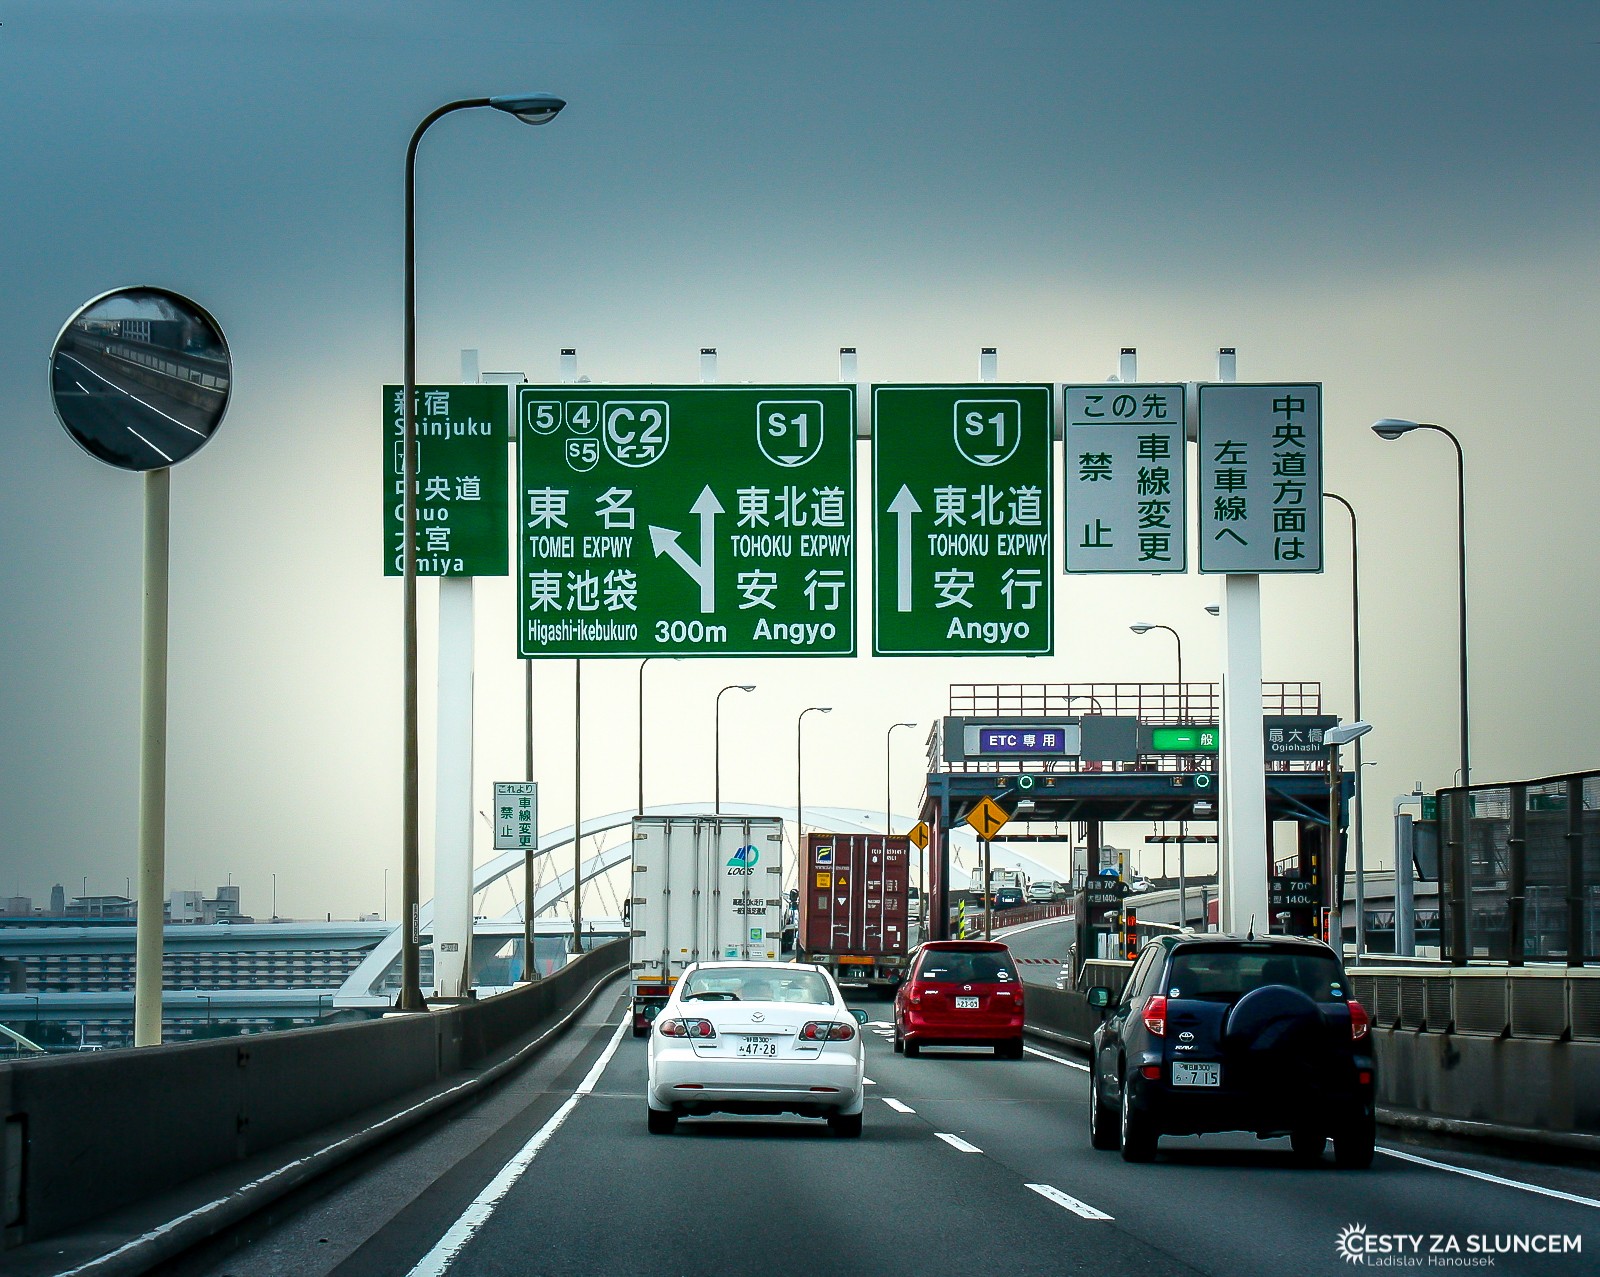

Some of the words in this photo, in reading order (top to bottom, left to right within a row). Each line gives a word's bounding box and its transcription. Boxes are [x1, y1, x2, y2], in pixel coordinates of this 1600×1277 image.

[536, 406, 554, 428] 5
[572, 406, 591, 428] 4
[1084, 393, 1168, 419] この先
[607, 408, 663, 444] C2
[768, 412, 808, 448] S1
[965, 412, 1005, 447] S1
[569, 444, 596, 463] S5
[1272, 394, 1307, 561] 中央道方面は
[736, 485, 845, 528] 東北道
[933, 484, 1042, 528] 東北道
[1078, 452, 1114, 549] 禁止
[1137, 433, 1172, 563] 車線変更
[1213, 439, 1248, 547] 左車線へ
[527, 486, 636, 530] 東名
[530, 536, 574, 559] TOMEI
[583, 536, 632, 559] EXPWY
[731, 534, 792, 557] TOHOKU
[800, 534, 850, 557] EXPWY
[928, 534, 988, 556] TOHOKU
[997, 534, 1048, 556] EXPWY
[528, 569, 638, 612] 東池袋
[737, 568, 845, 611] 安行
[933, 568, 1042, 610] 安行
[528, 618, 638, 646] Higashi-ikebukuro
[654, 621, 727, 643] 300m
[753, 618, 836, 644] Angyo
[946, 616, 1030, 643] Angyo
[989, 735, 1017, 747] ETC
[1023, 734, 1056, 748] 専用
[1177, 733, 1213, 746] 一般
[1268, 728, 1323, 743] 扇大橋
[1271, 743, 1320, 753] Ogiohashi
[498, 784, 533, 794] これより
[500, 806, 514, 838] 禁止
[518, 796, 532, 847] 車線変更
[727, 867, 754, 876] LOGS
